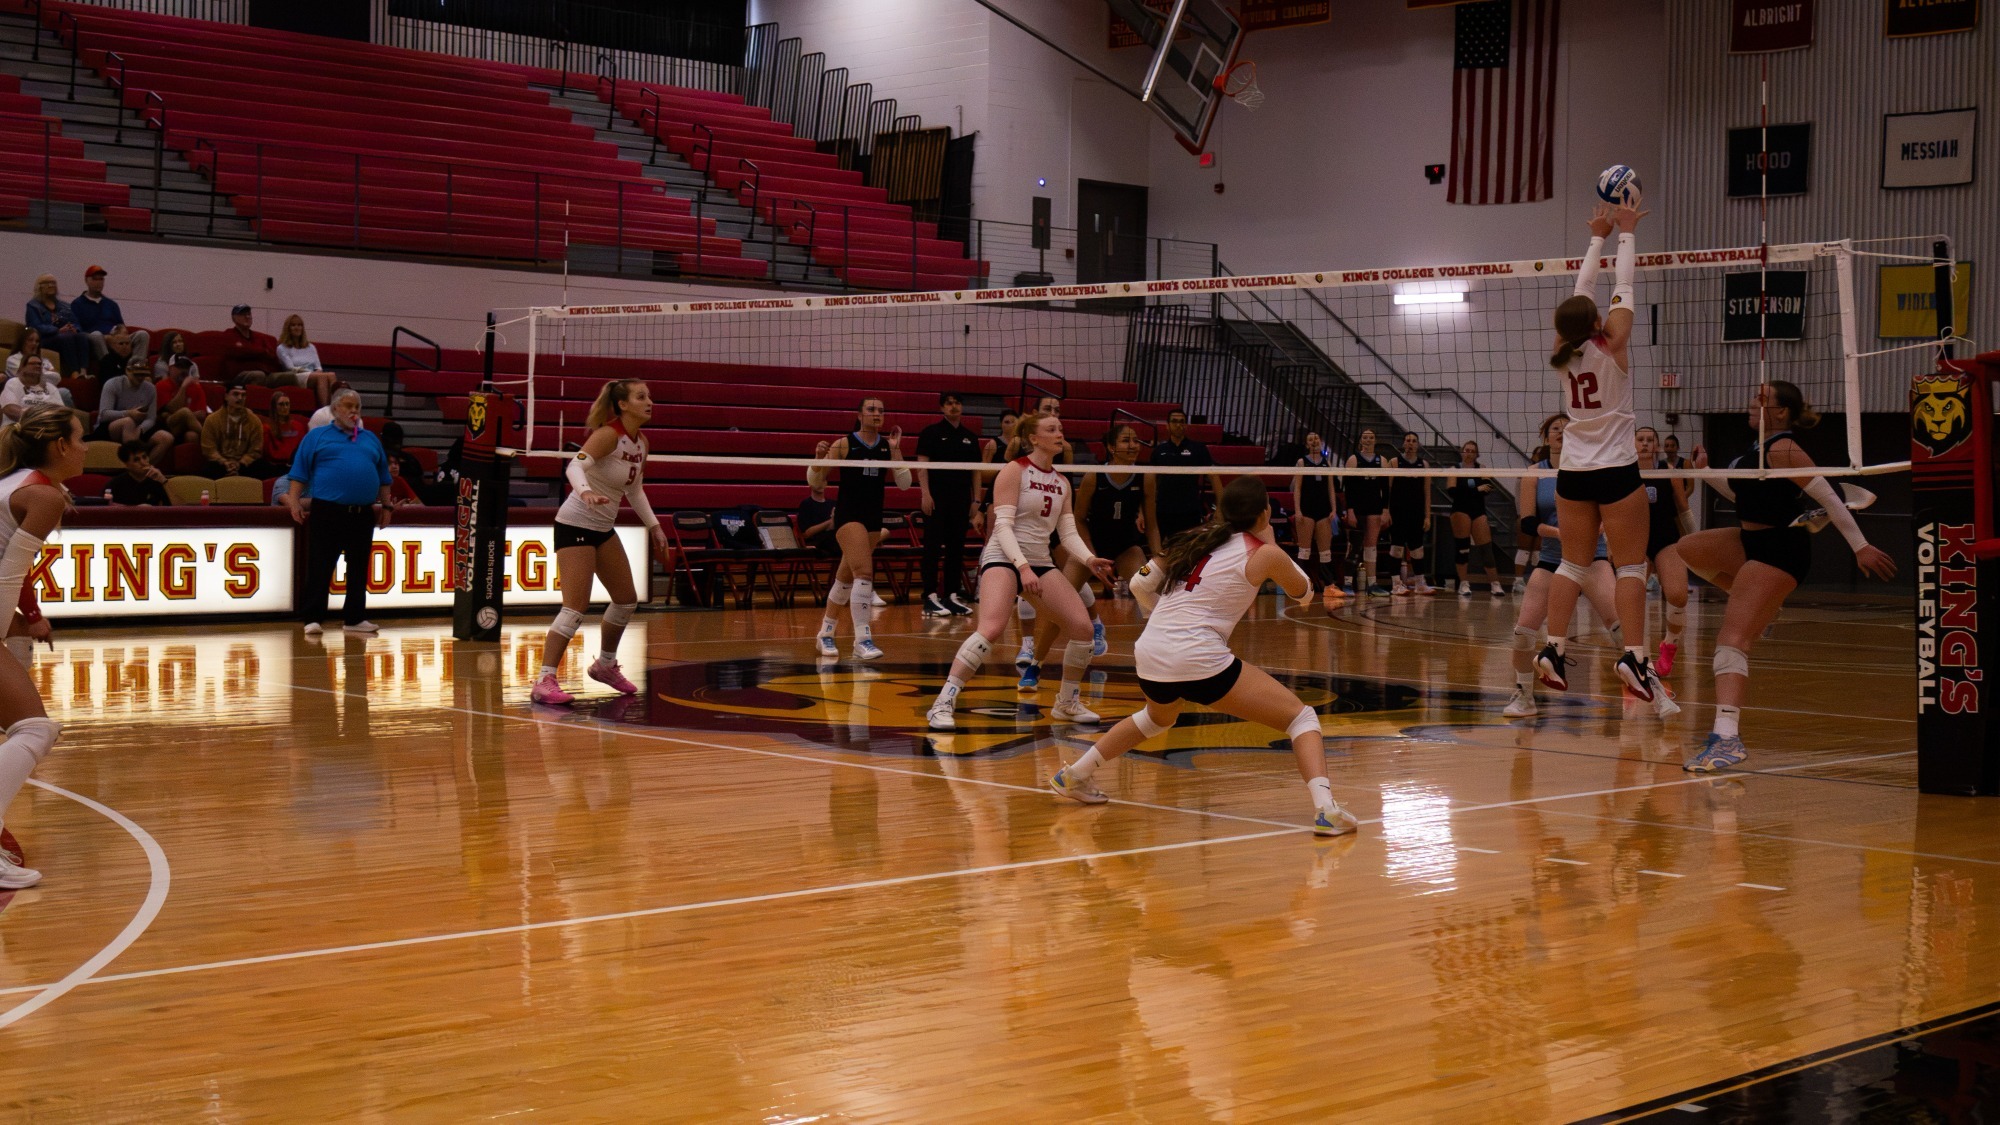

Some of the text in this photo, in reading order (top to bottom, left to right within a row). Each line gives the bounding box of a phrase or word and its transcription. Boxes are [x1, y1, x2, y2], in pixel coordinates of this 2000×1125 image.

[1744, 4, 1802, 27] ALBRIGHT
[1901, 139, 1958, 161] MESSIAH
[1745, 151, 1791, 171] HOOD
[1566, 257, 1608, 270] KIS
[1677, 250, 1762, 264] VOLLEYBALL
[1342, 264, 1514, 283] KING'S COLLEGE VOLLEYBALL
[976, 285, 1108, 300] KING'S COLLEGE VOLLEYBALL
[1147, 276, 1297, 292] KING'S COLLEGE VOLLEYBALL
[591, 306, 620, 314] COLLEGE
[622, 305, 662, 313] VOLLEYBALL
[714, 302, 747, 310] COLLEGE
[749, 300, 793, 308] VOLLEYBALL
[825, 293, 941, 306] KING'S COLLEGE VOLLEYBALL
[1728, 295, 1801, 316] STEVENSON
[1568, 371, 1602, 409] 12
[1662, 374, 1677, 387] EXIT
[625, 466, 637, 486] 9
[1030, 479, 1063, 496] KING'S
[1040, 495, 1053, 518] 3
[1112, 501, 1122, 520] 1
[455, 477, 473, 593] KING'S
[466, 479, 480, 593] VOLLEYBALL
[30, 542, 260, 603] KING'S
[485, 540, 496, 600] sports imports
[1917, 522, 1936, 715] VOLLEYBALL
[1938, 522, 1984, 715] KING'S
